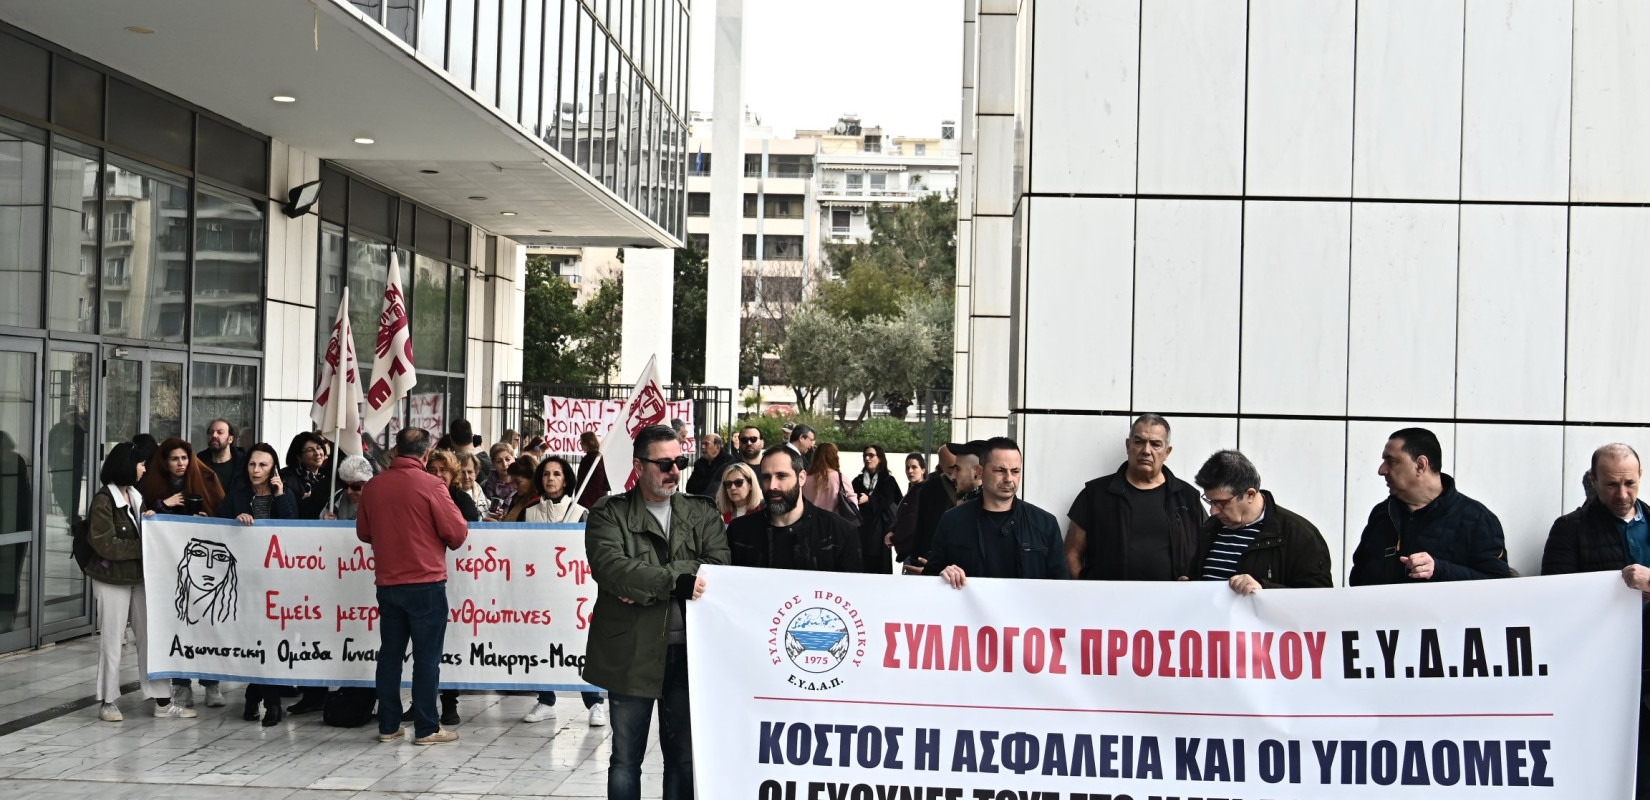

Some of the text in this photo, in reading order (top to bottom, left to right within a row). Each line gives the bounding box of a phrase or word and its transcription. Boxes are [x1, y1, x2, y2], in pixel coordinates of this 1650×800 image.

[264, 534, 326, 571] Αυτοί
[455, 544, 511, 582] κέρδη
[266, 590, 323, 631] Εμείς
[337, 605, 380, 632] μετρ
[446, 598, 552, 637] νθρώπινες
[768, 590, 866, 667] ΣΥΛΛΟΓΟΣ ΠΡΟΣΩΠΙΚΟΥ
[169, 634, 266, 665] Αγωνιστική
[277, 639, 333, 670] Ομάδα
[804, 656, 828, 665] 1975
[882, 621, 1549, 681] ΣΥΛΛΟΓΟΣ ΠΡΟΣΩΠΙΚΟΥ Ε.Υ.Δ.Α.Π.
[787, 674, 844, 691] Ε.Υ.Δ.Α.Π.
[758, 721, 1555, 787] ΚΟΣΤΟΣ Η ΑΣΦΑΛΕΙΑ ΚΑΙ ΟΙ ΥΠΟΔΟΜΕΣ
